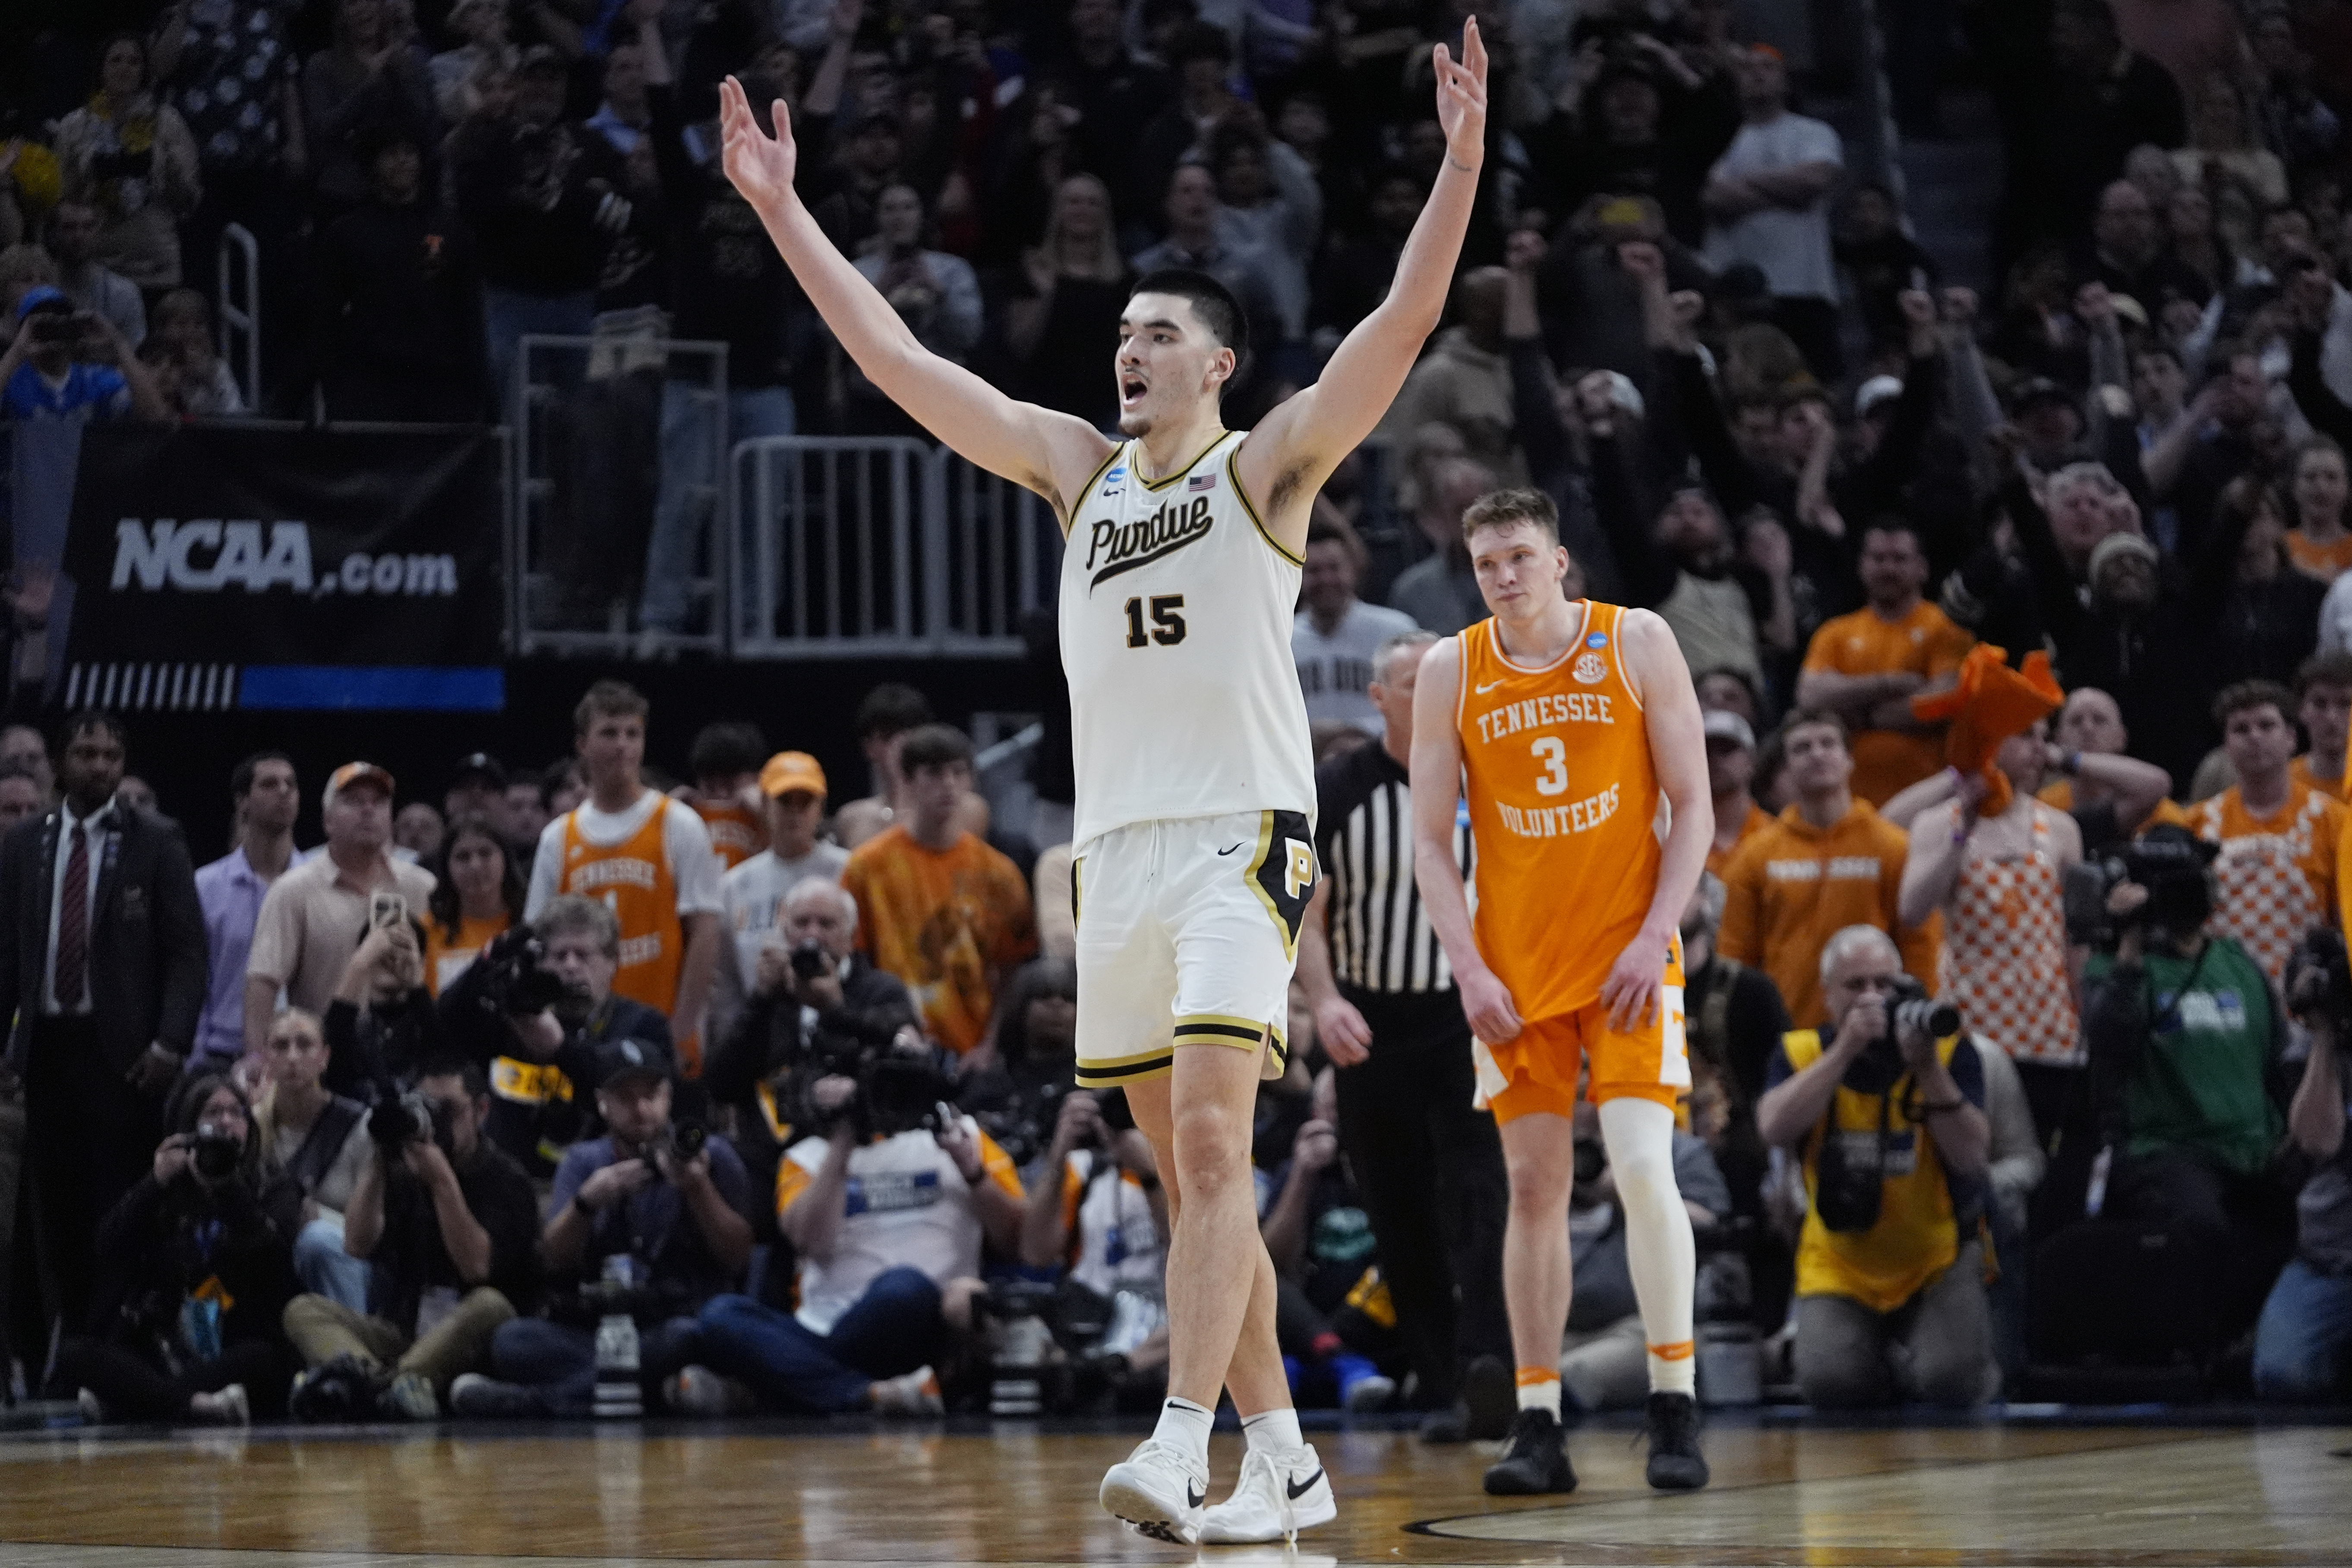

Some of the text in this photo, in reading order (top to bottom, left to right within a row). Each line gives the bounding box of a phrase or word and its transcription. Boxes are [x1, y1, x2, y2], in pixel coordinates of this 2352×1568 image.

[1086, 495, 1213, 571] Purdue
[1125, 594, 1187, 648] 15
[1476, 692, 1615, 745] TENNESSEE
[1531, 736, 1569, 797] 3
[1495, 782, 1620, 838] VOLUNTEERS
[1285, 836, 1313, 900] P
